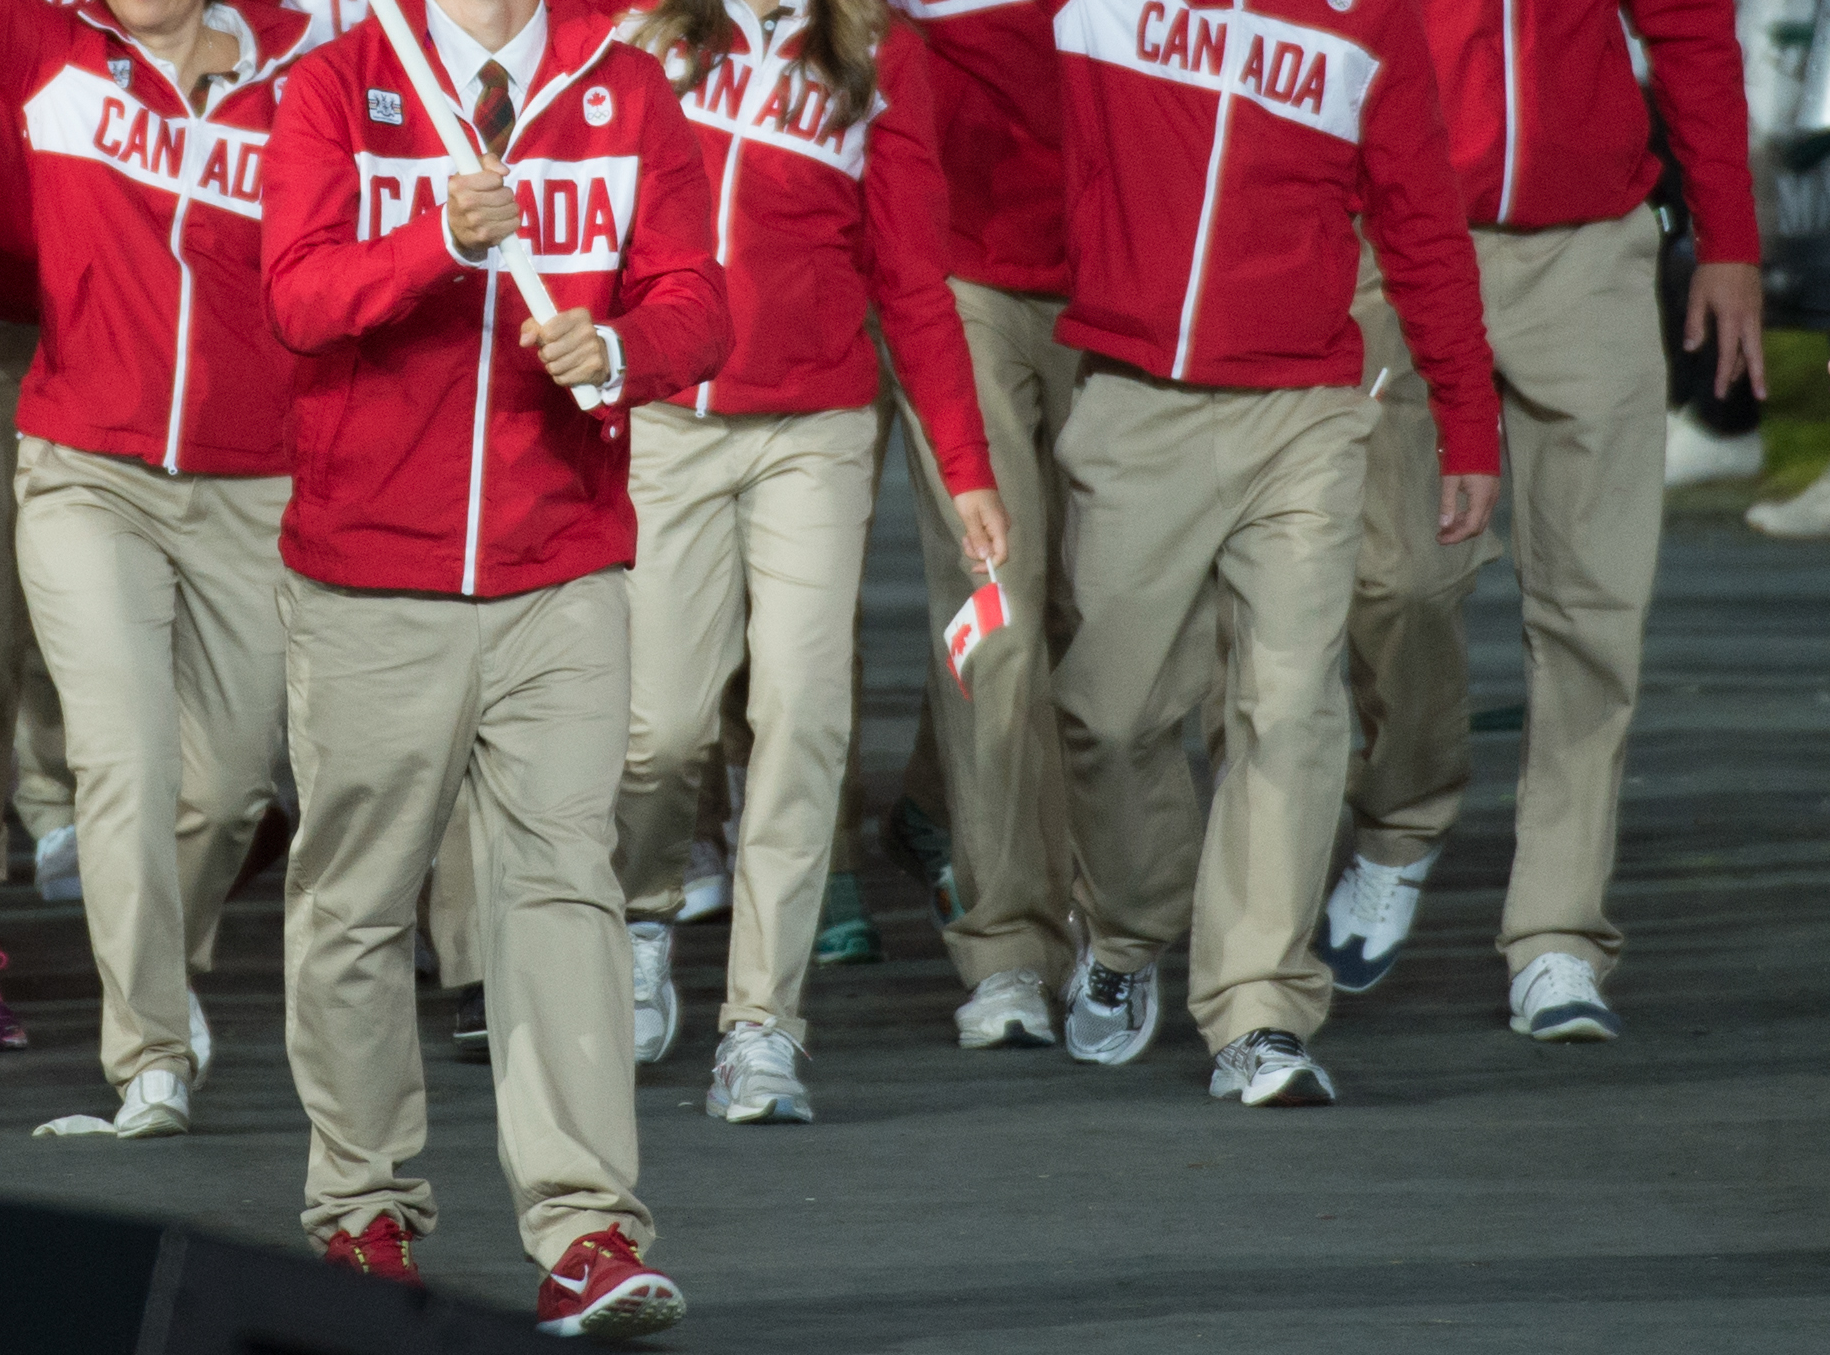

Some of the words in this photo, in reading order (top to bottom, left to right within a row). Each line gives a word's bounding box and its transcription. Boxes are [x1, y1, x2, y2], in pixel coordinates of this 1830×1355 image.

[1135, 0, 1327, 115] CANADA
[93, 95, 264, 203] CANAD
[370, 175, 619, 256] CAADA
